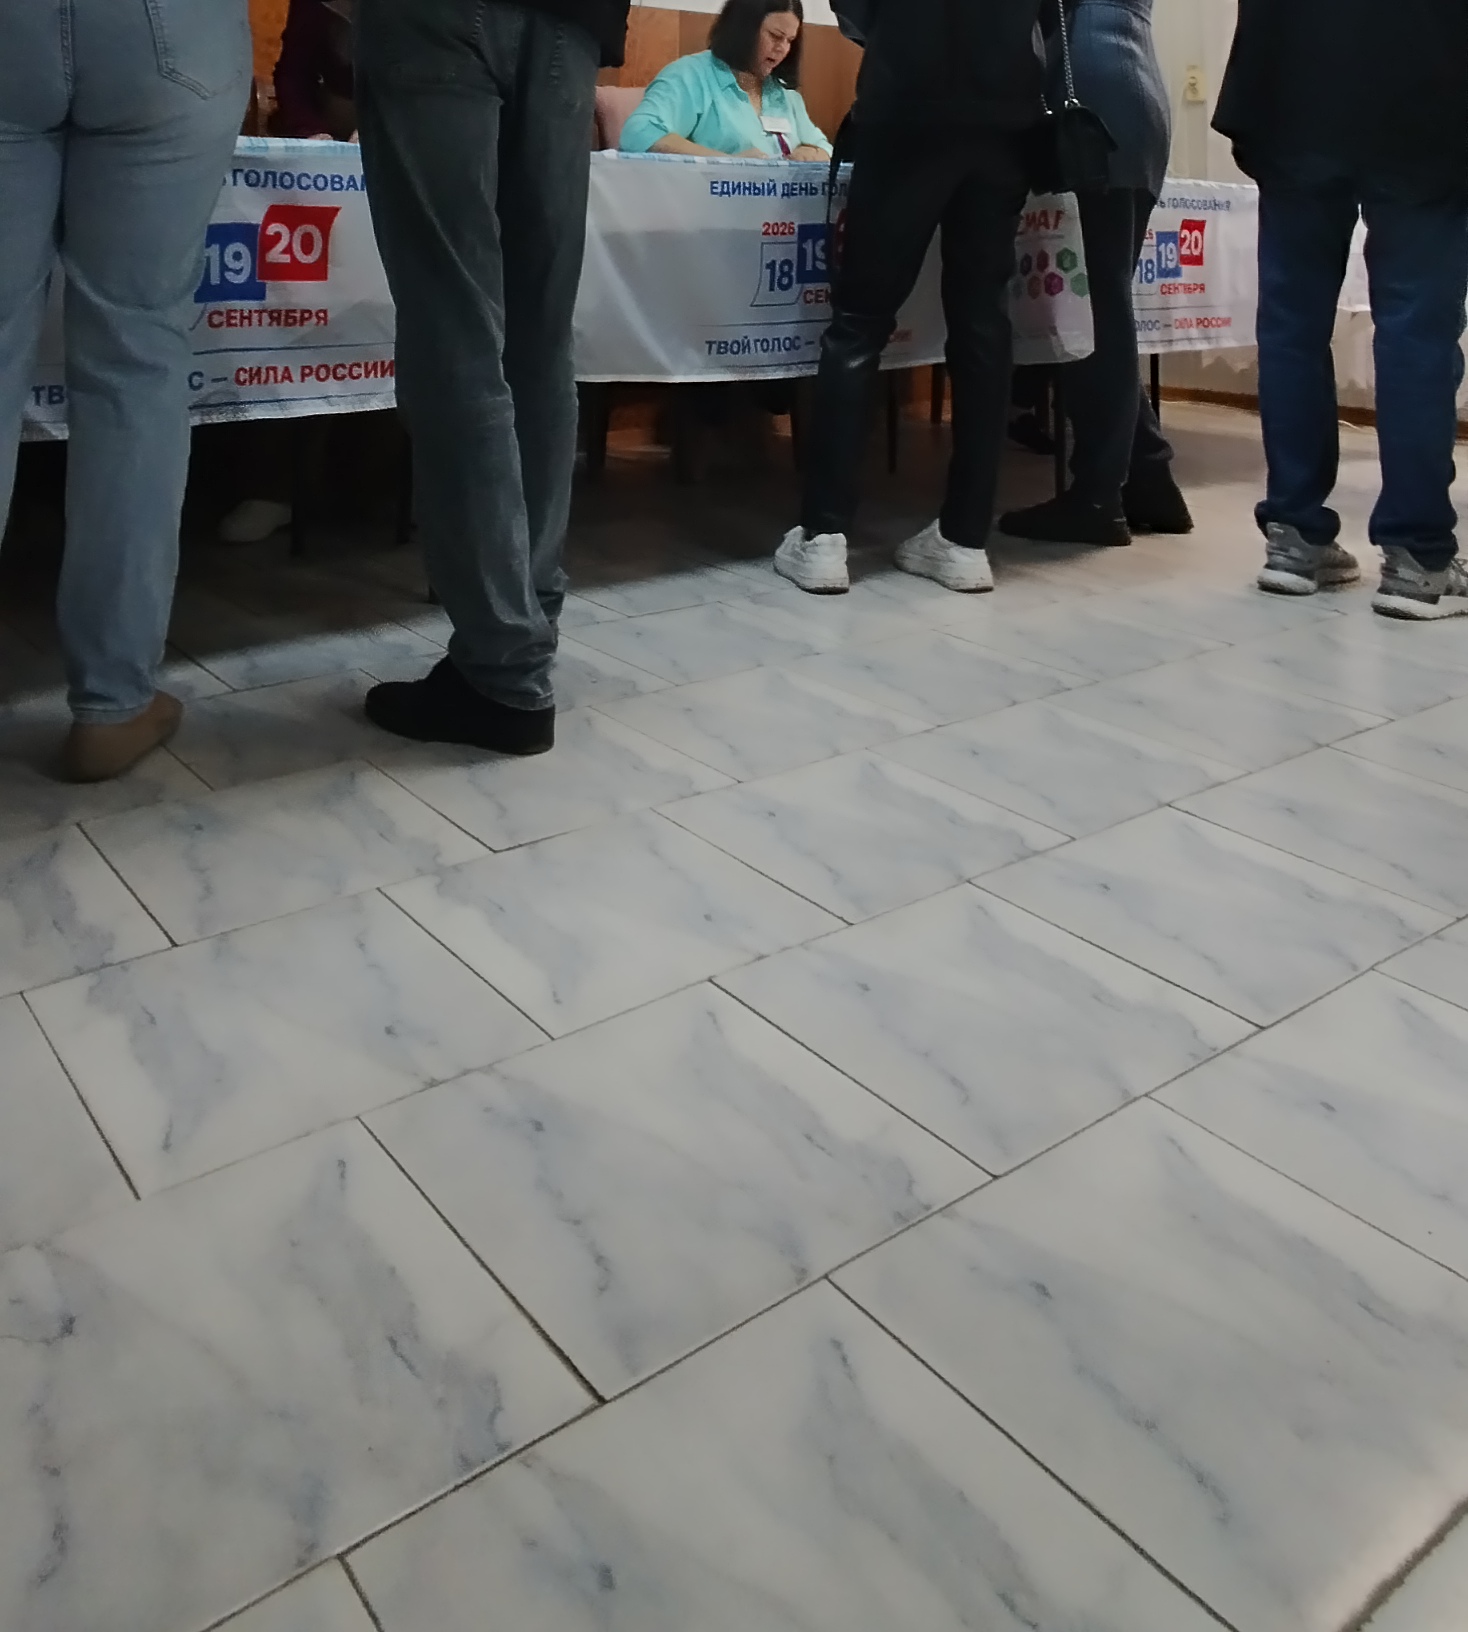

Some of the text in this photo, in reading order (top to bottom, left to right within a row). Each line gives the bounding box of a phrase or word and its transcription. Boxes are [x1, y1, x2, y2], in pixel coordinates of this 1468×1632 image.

[231, 169, 365, 191] ГОЛОСОВА
[710, 179, 776, 197] ЕДИНЫЙ
[781, 182, 818, 197] ДЕНЬ
[762, 221, 795, 236] 2026
[204, 223, 323, 285] 19 20
[1139, 229, 1203, 284] 18 19 20
[764, 258, 795, 292] 18
[1160, 282, 1206, 295] СЕНТЯБРЯ
[207, 308, 329, 329] СЕНТЯБРЯ
[1135, 319, 1161, 331] ОЛОС
[705, 336, 751, 355] ТВОЙ
[754, 336, 802, 353] ГОЛОС
[31, 385, 66, 406] ТВ
[234, 365, 294, 386] СИЛА
[300, 359, 396, 383] РОССИИ
